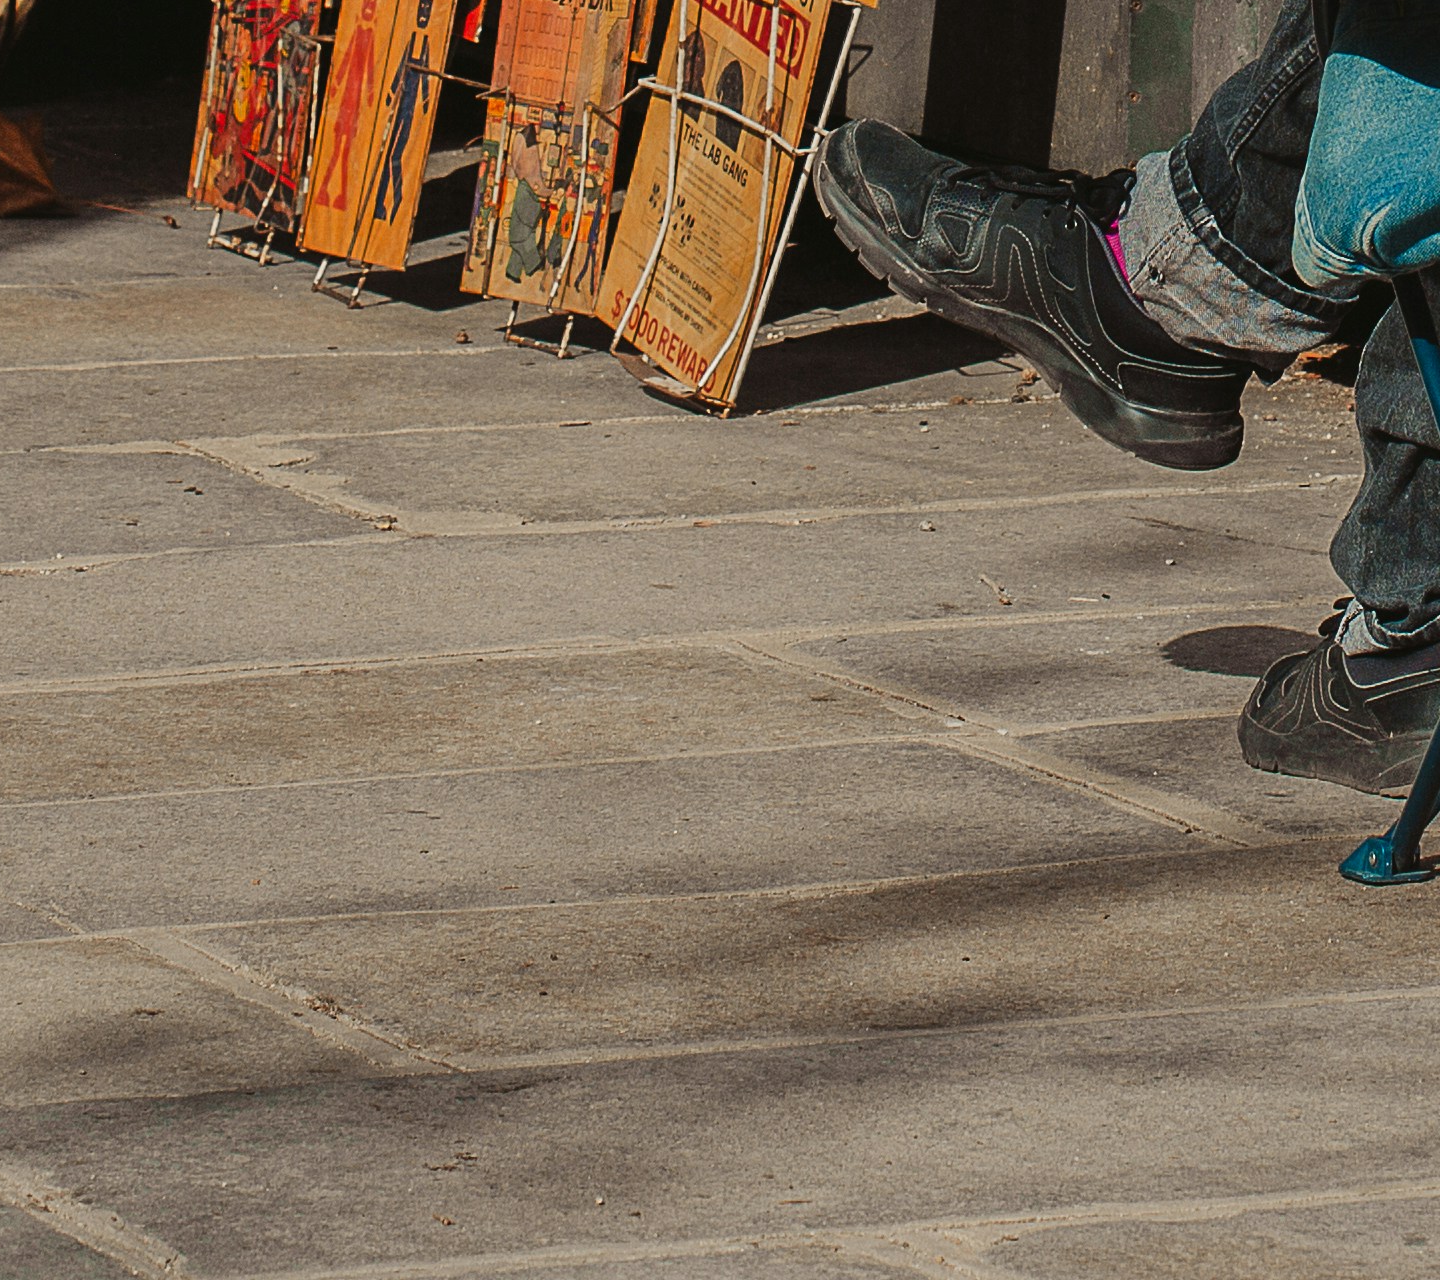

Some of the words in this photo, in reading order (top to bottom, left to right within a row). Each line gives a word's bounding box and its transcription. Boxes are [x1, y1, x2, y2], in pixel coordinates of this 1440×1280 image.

[684, 122, 702, 147] THE
[703, 135, 722, 165] LAB
[722, 154, 748, 188] GANG
[692, 281, 713, 303] CAUTION
[657, 327, 716, 393] REWARD
